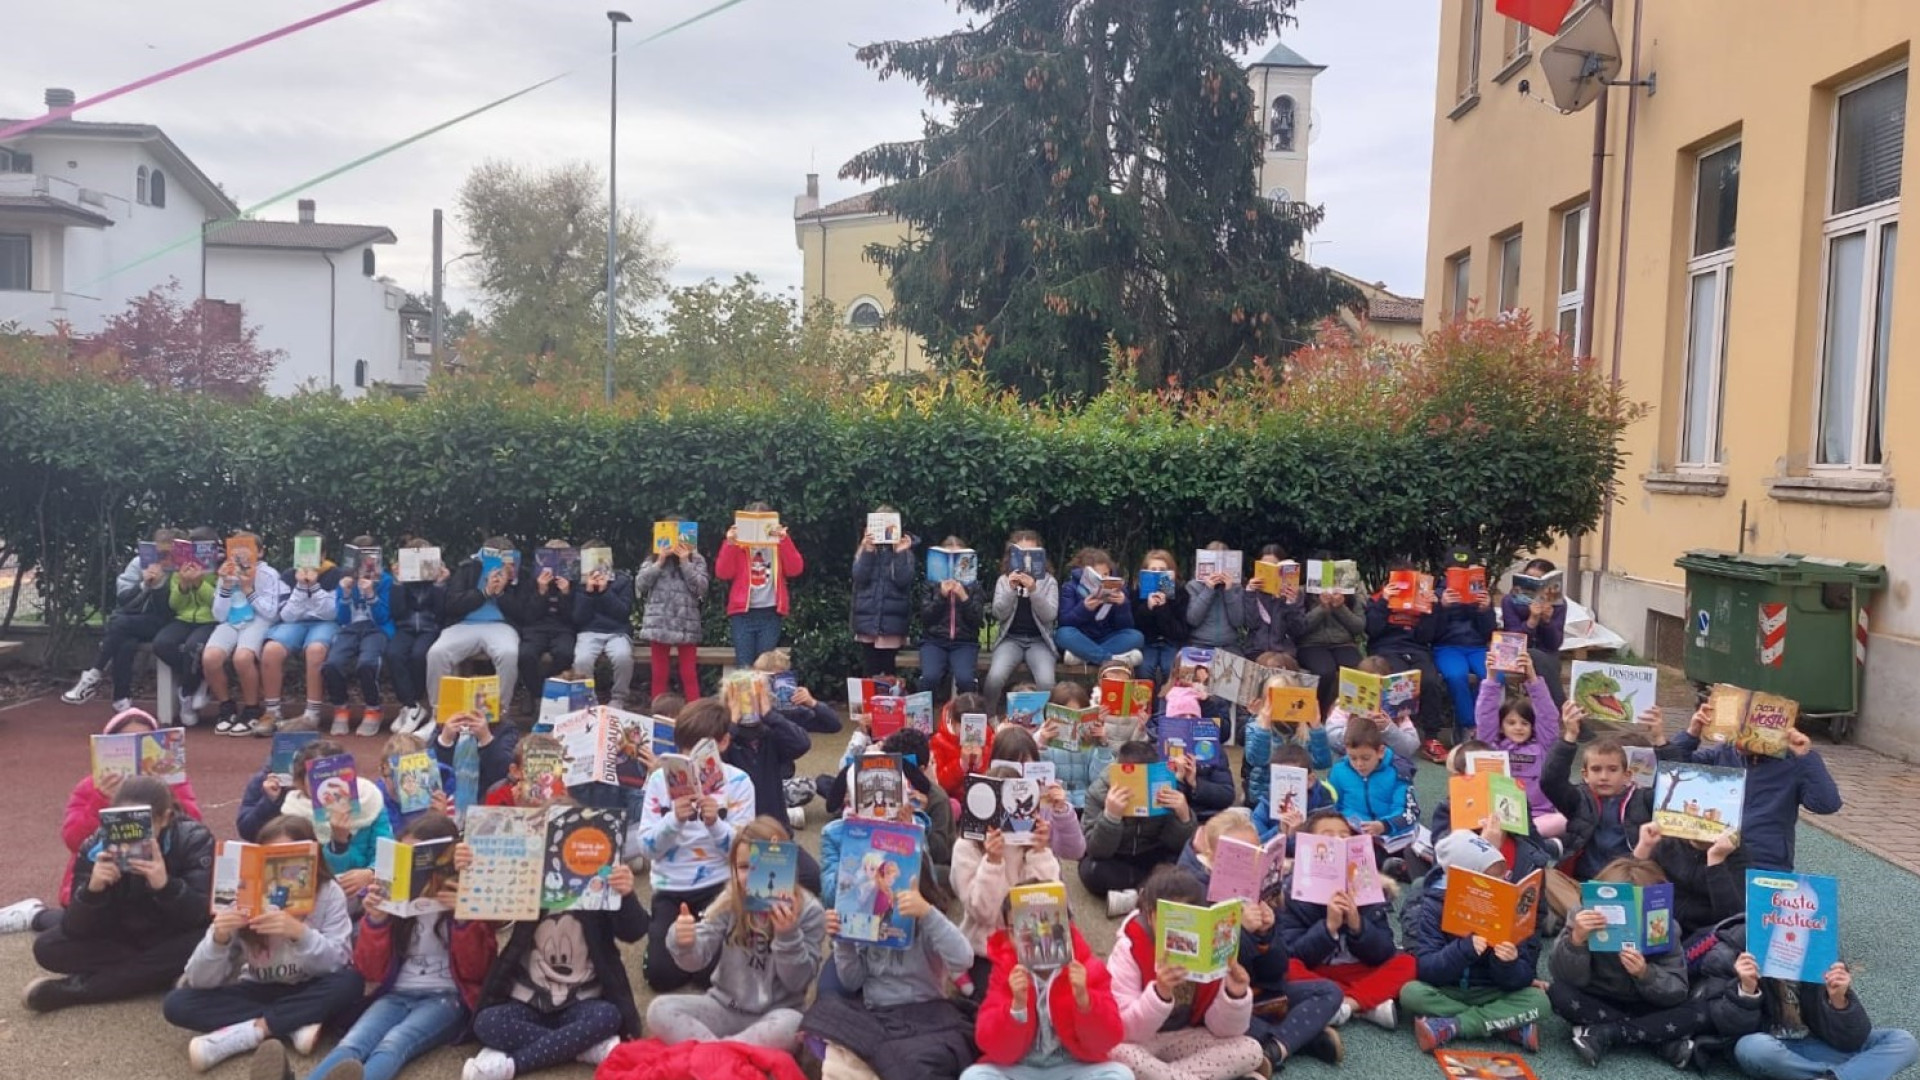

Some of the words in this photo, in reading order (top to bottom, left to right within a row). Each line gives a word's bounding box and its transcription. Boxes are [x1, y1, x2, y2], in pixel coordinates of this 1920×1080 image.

[605, 716, 621, 782] DINOSAURI
[1772, 892, 1816, 910] Basta
[1763, 911, 1827, 930] plastica!
[1518, 1008, 1540, 1023] PLAY
